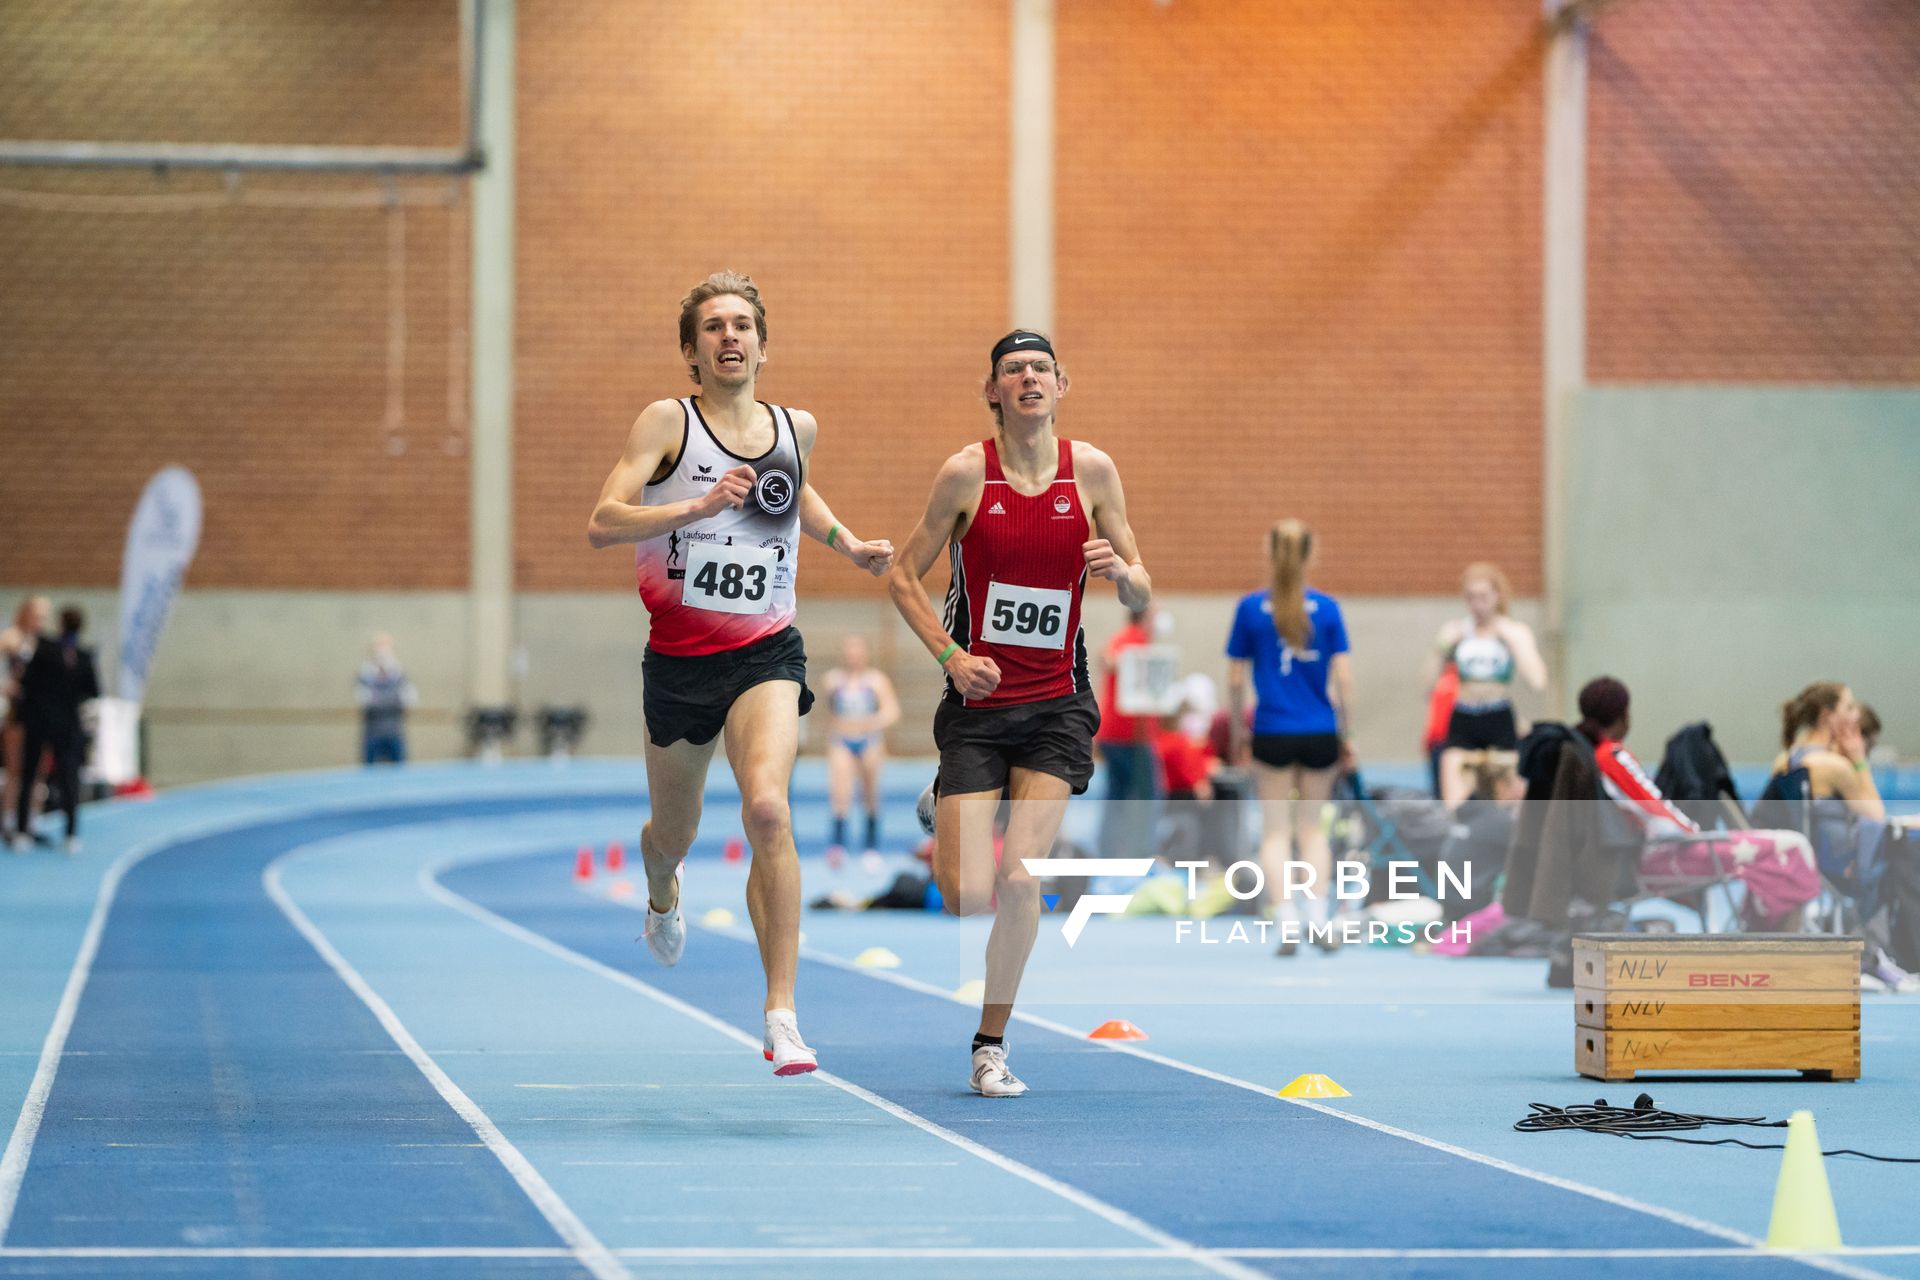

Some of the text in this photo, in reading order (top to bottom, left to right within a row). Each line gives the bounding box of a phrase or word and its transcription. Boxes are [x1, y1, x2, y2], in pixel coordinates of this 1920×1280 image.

[692, 475, 717, 483] erima
[682, 530, 717, 542] Laufsport
[693, 561, 767, 601] 483
[991, 598, 1062, 636] 596
[1618, 959, 1668, 979] NLV
[1689, 973, 1771, 987] BENZ
[1622, 1000, 1666, 1016] NLV
